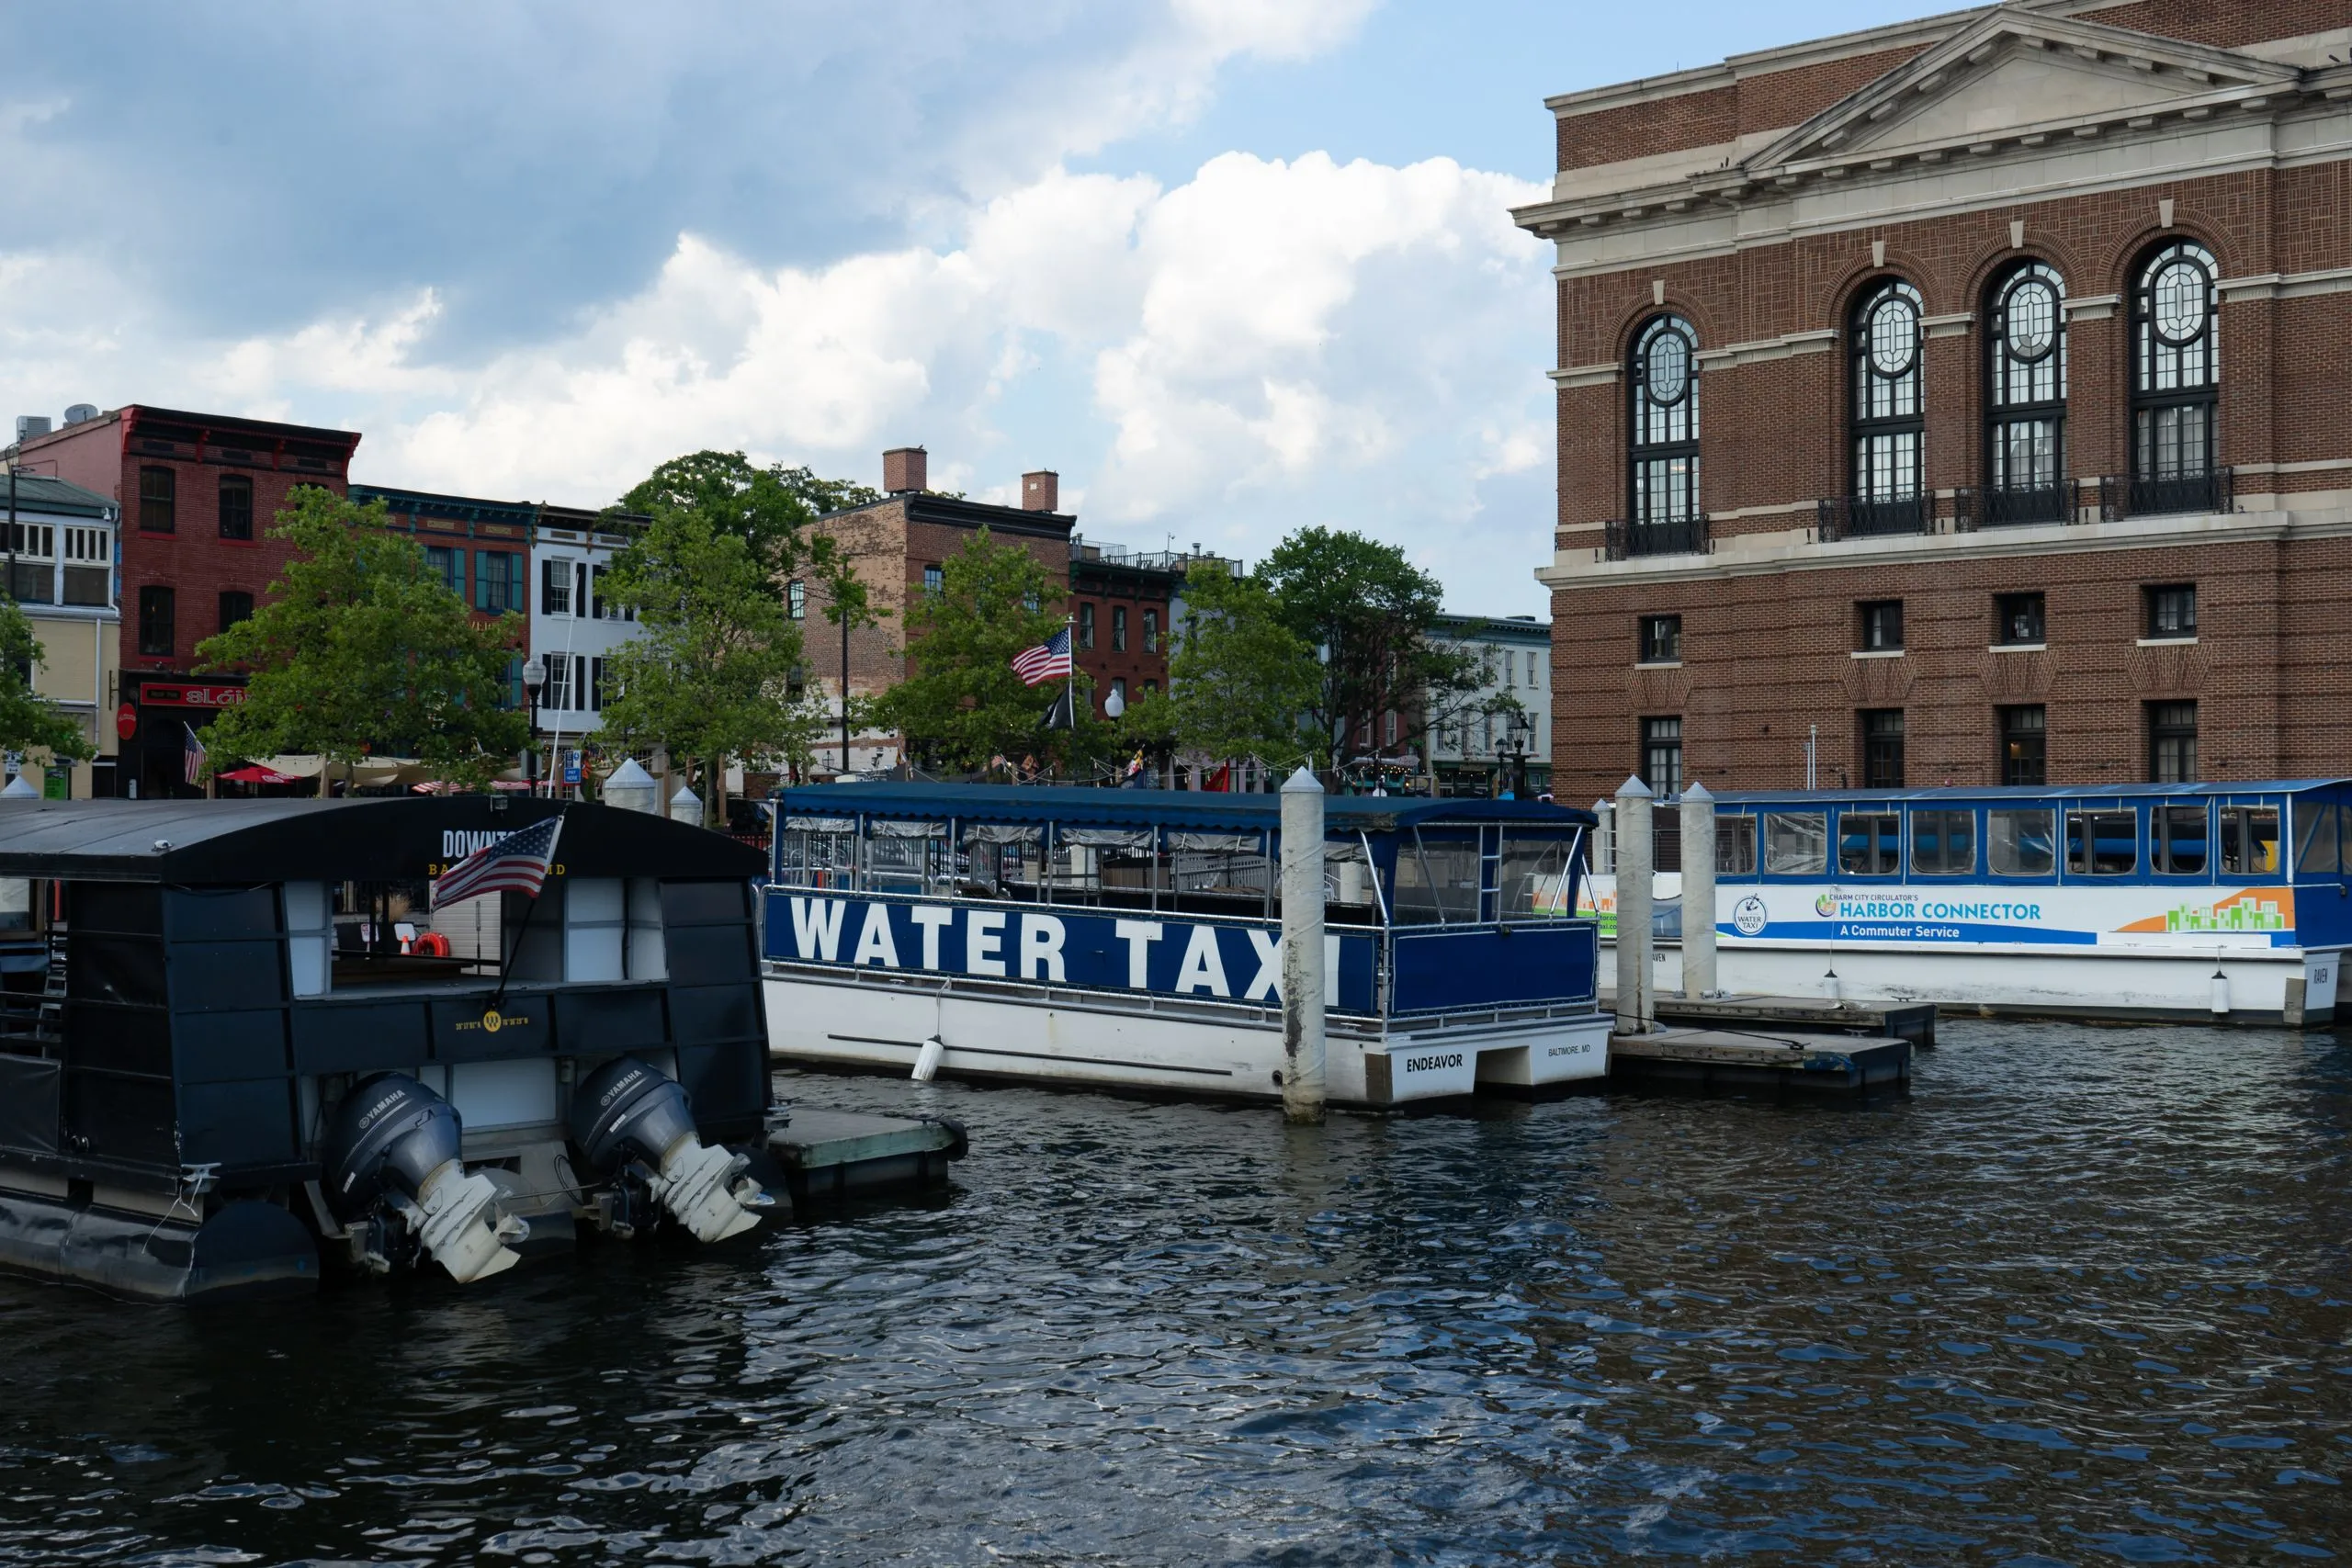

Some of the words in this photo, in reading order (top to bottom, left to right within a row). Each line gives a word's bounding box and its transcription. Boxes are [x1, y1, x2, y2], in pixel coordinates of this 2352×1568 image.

[1871, 894, 1918, 902] CIRCULATOR'S
[1840, 902, 1916, 919] HARBOR
[1922, 903, 2041, 919] CONNECTOR
[1840, 925, 1849, 936] A
[1851, 925, 1913, 937] Commuter
[1916, 926, 1960, 938] Service
[790, 897, 1067, 983] WATER
[1115, 919, 1340, 1008] TAXI
[1581, 1043, 1591, 1053] MD
[1407, 1054, 1463, 1072] ENDEAVOR
[607, 1069, 642, 1097] YAMAHA
[368, 1089, 406, 1119] YAMAHA
